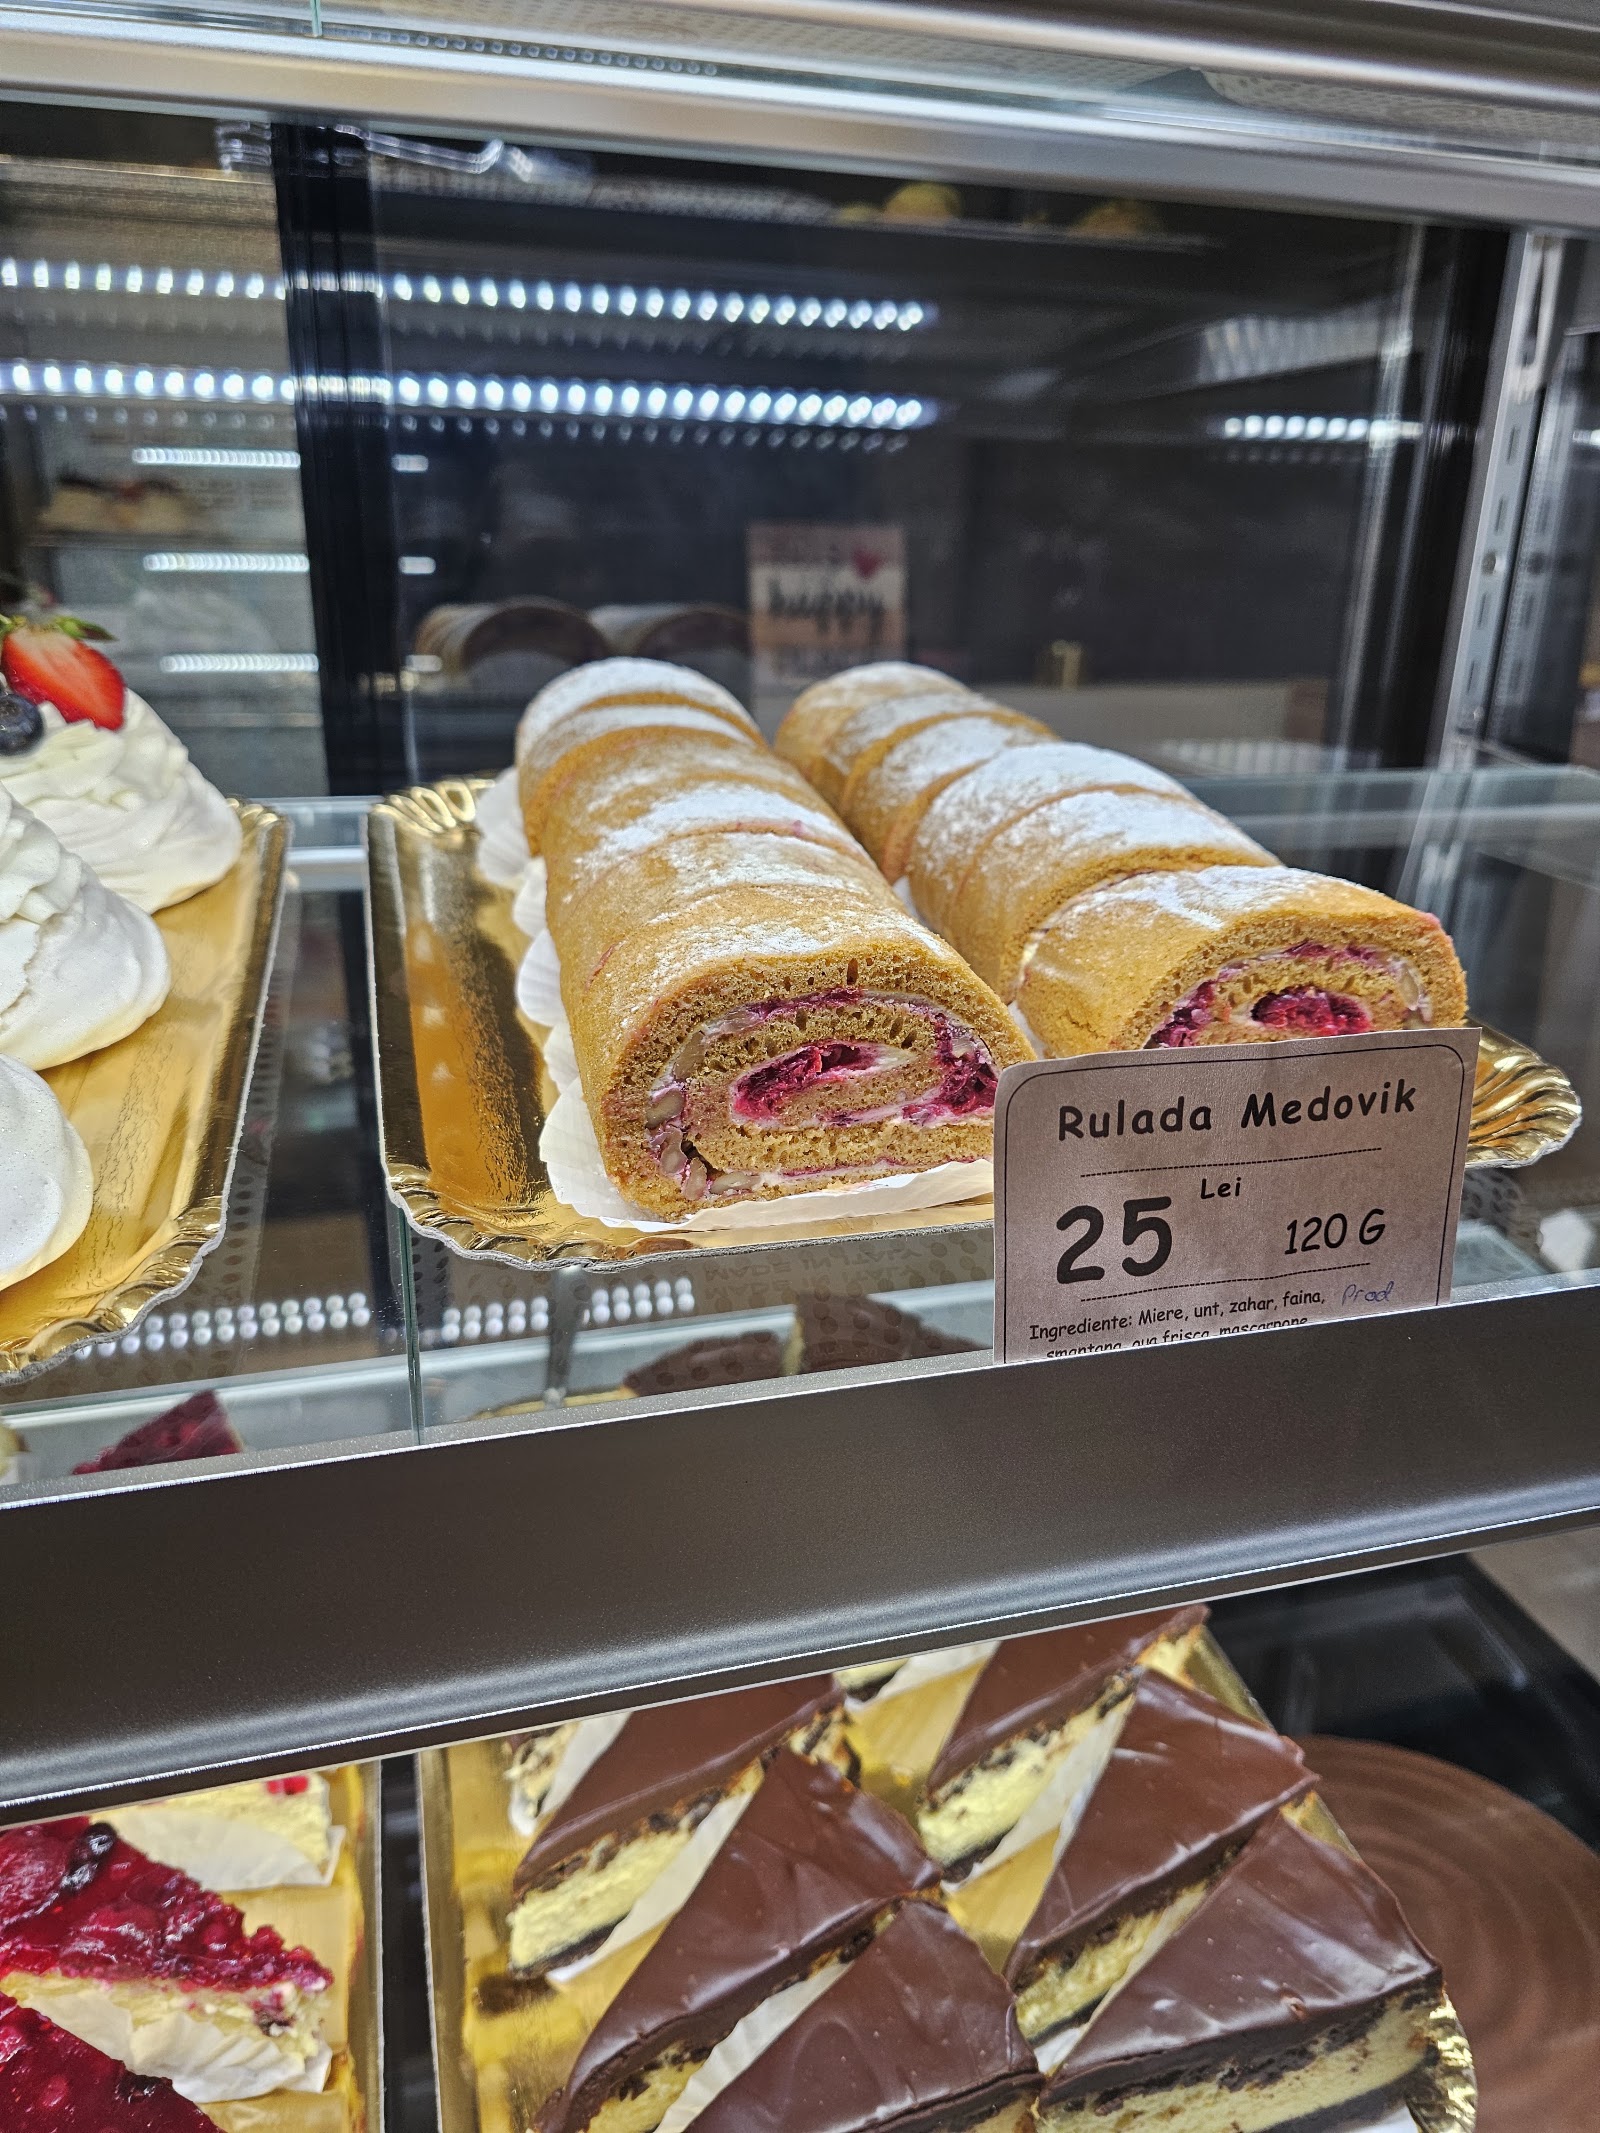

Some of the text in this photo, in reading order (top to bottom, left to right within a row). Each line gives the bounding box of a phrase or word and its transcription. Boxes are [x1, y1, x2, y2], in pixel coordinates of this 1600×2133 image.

[1058, 1079, 1418, 1142] Rulada Medovik
[1200, 1177, 1243, 1200] Lei
[1056, 1196, 1173, 1285] 25
[1284, 1208, 1386, 1255] 120 G
[1029, 1291, 1326, 1343] Ingrediente: Miere, unt, zahar, faina,
